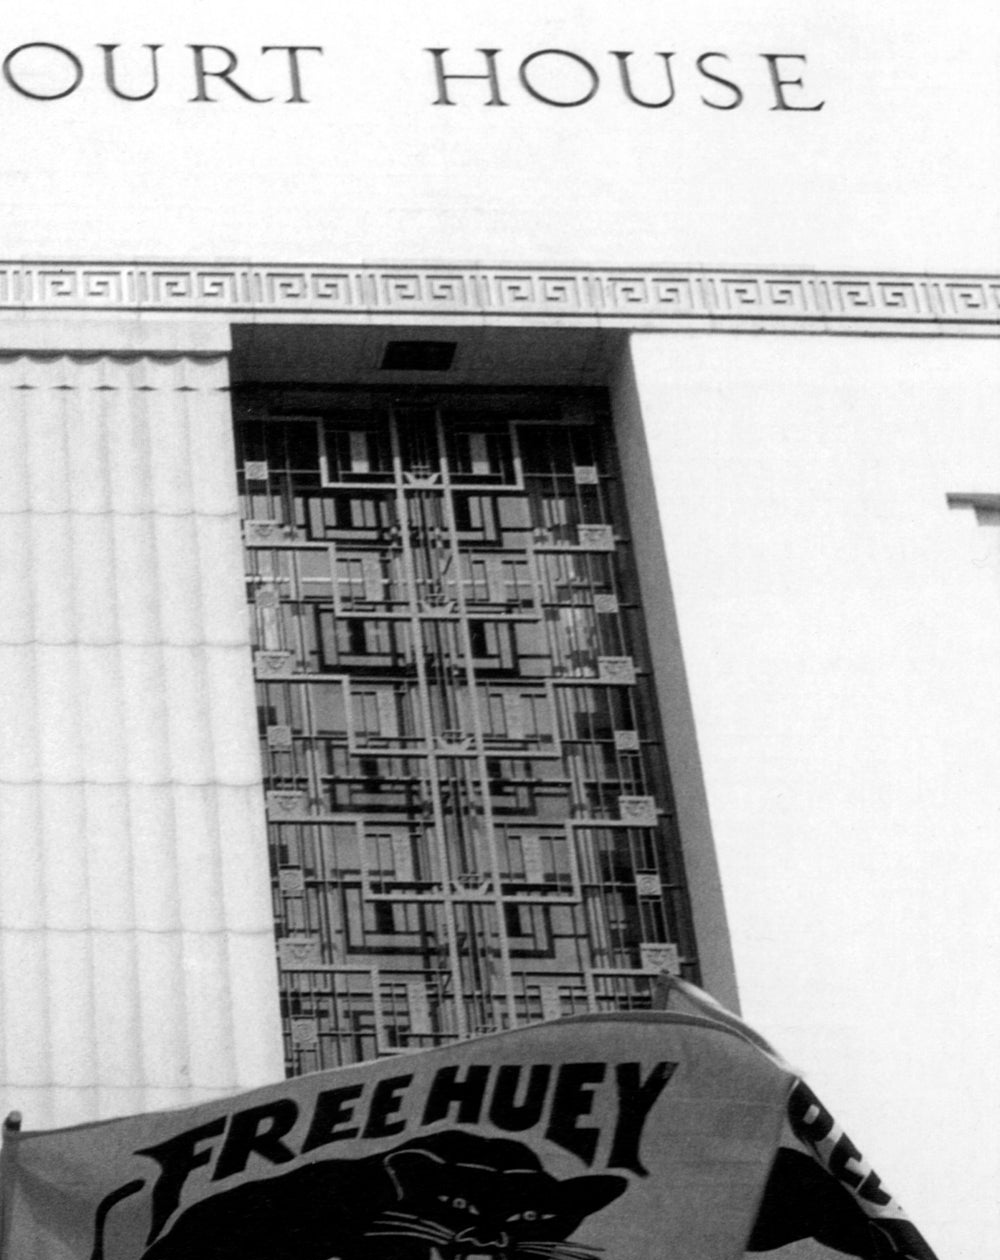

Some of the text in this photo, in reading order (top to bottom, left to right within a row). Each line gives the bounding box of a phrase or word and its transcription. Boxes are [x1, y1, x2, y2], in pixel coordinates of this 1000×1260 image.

[423, 46, 826, 112] HOUSE
[132, 1060, 679, 1248] FREE HUEY
